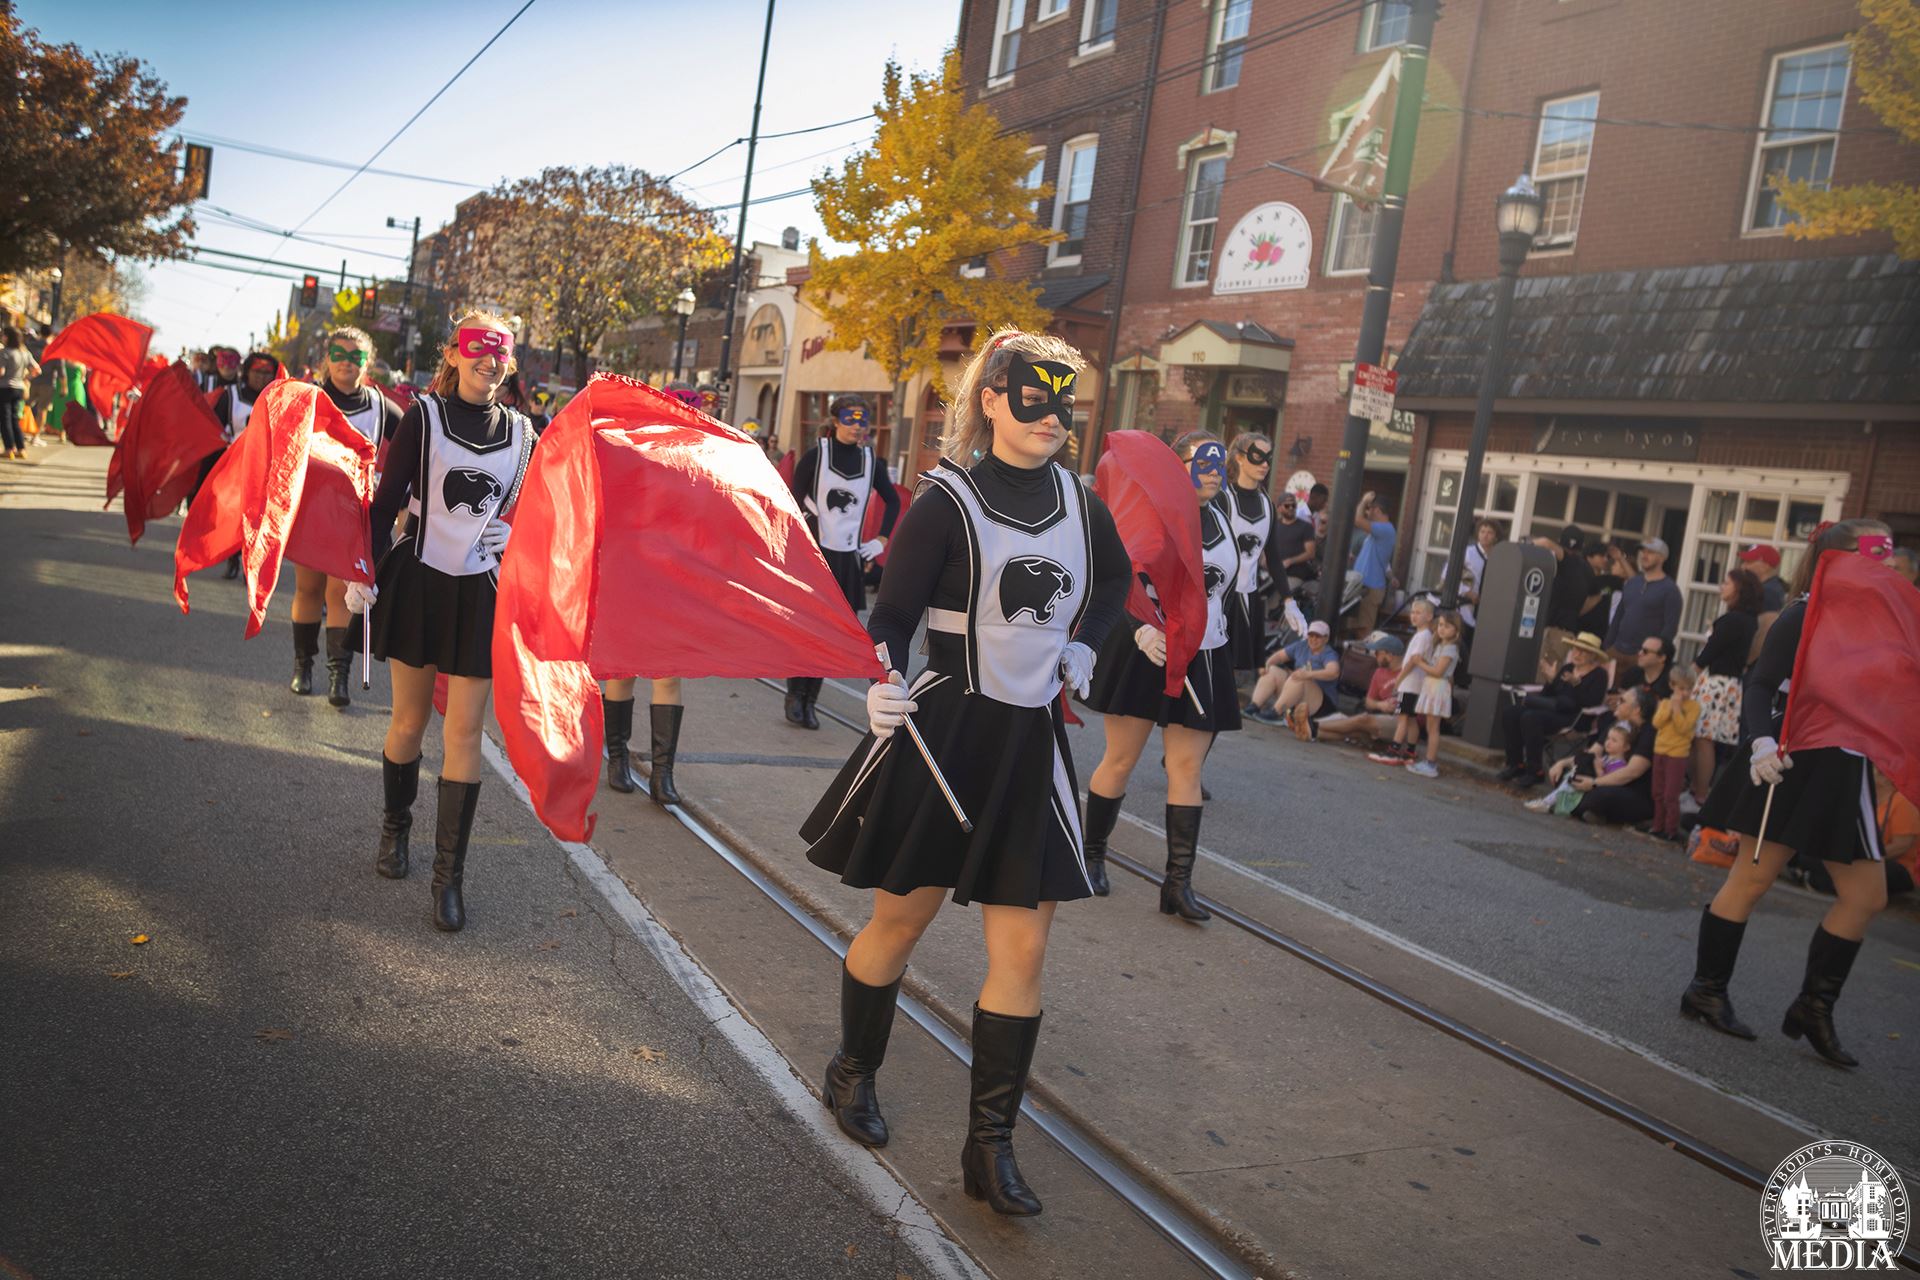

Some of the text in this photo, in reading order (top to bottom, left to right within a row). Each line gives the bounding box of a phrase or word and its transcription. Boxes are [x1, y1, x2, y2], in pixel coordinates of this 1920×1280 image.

[1192, 350, 1206, 362] 110
[1358, 370, 1394, 387] EMERGENCY
[1561, 428, 1693, 449] rye byob
[1206, 446, 1221, 458] A
[1529, 572, 1541, 592] P
